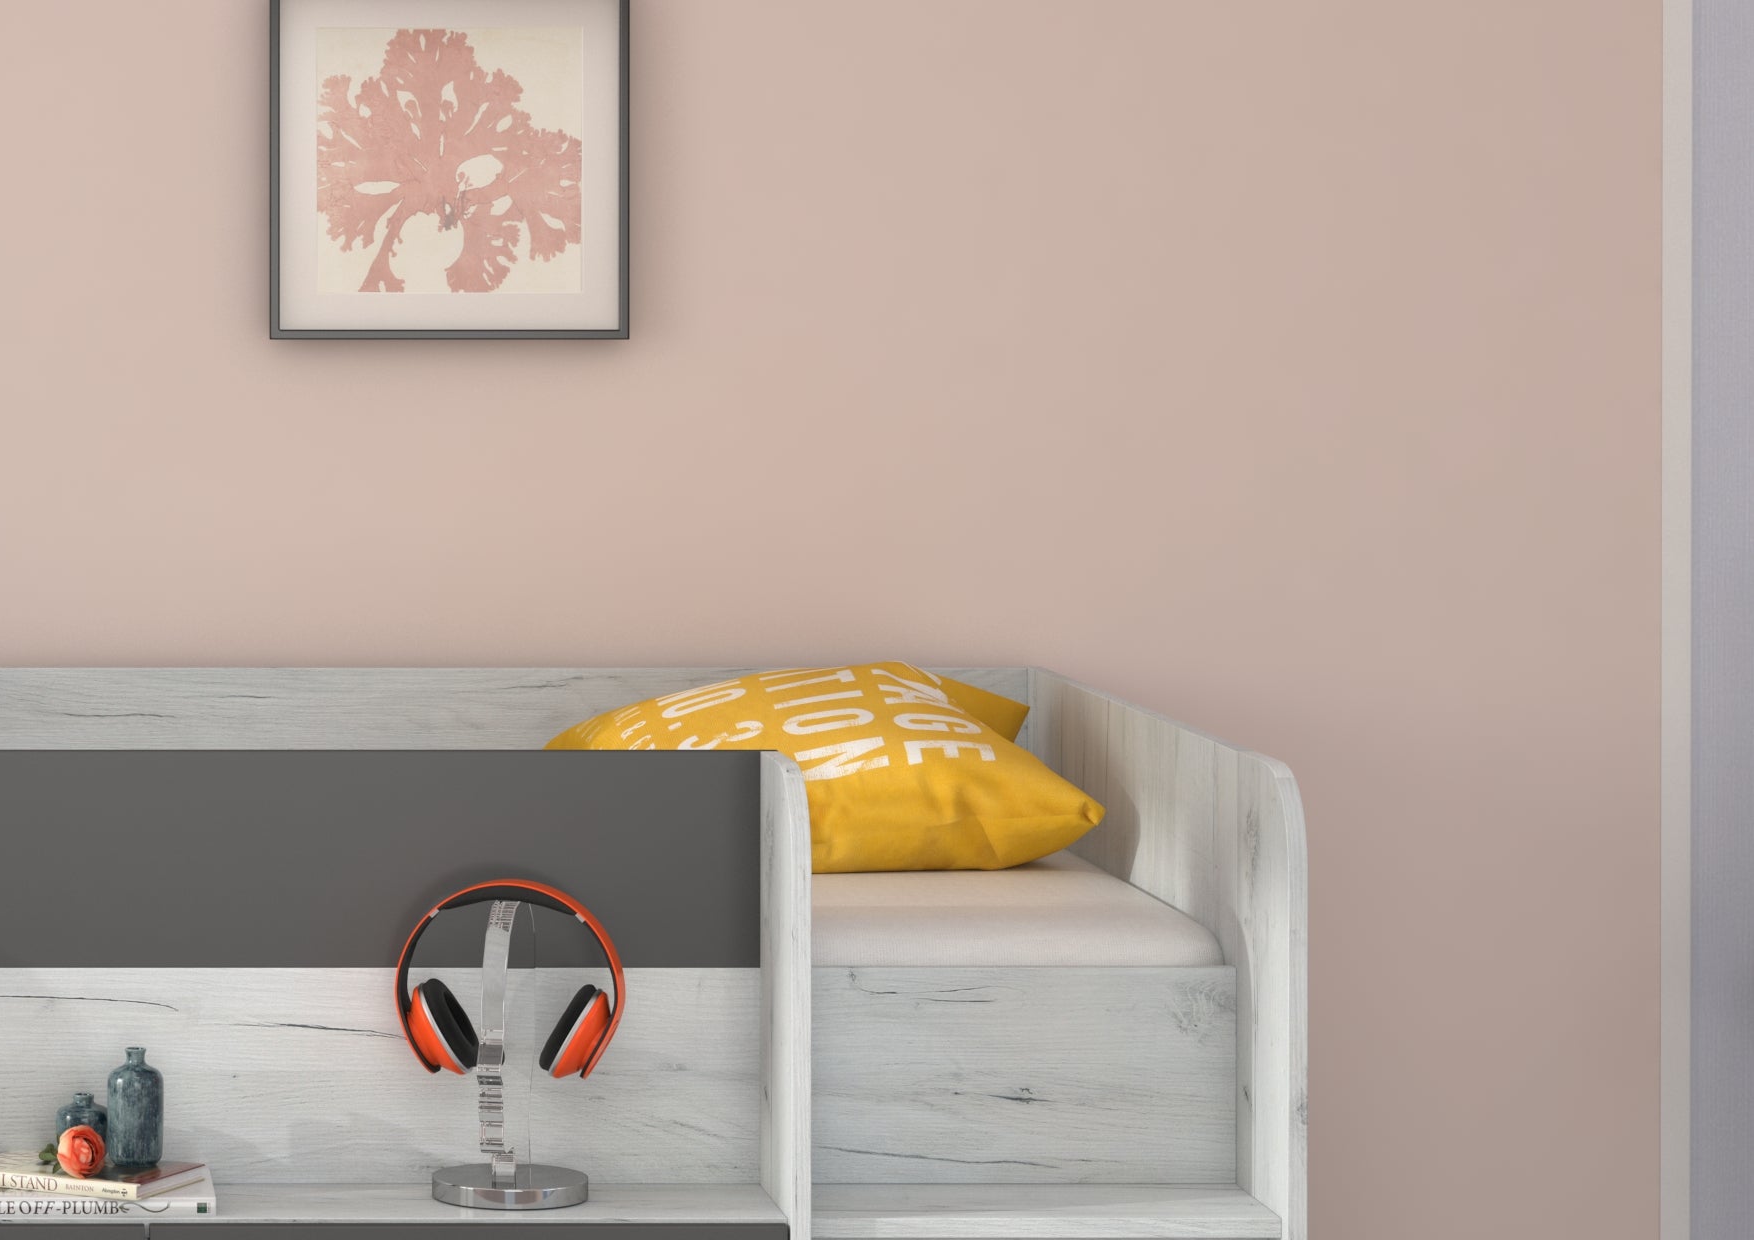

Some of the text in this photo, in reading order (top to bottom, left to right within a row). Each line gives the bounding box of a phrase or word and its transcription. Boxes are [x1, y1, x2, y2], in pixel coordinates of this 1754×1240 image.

[1, 1173, 6, 1186] I
[10, 1174, 57, 1191] STAND
[65, 1184, 94, 1192] BAINTON
[19, 1201, 119, 1215] OFF-PLUMB
